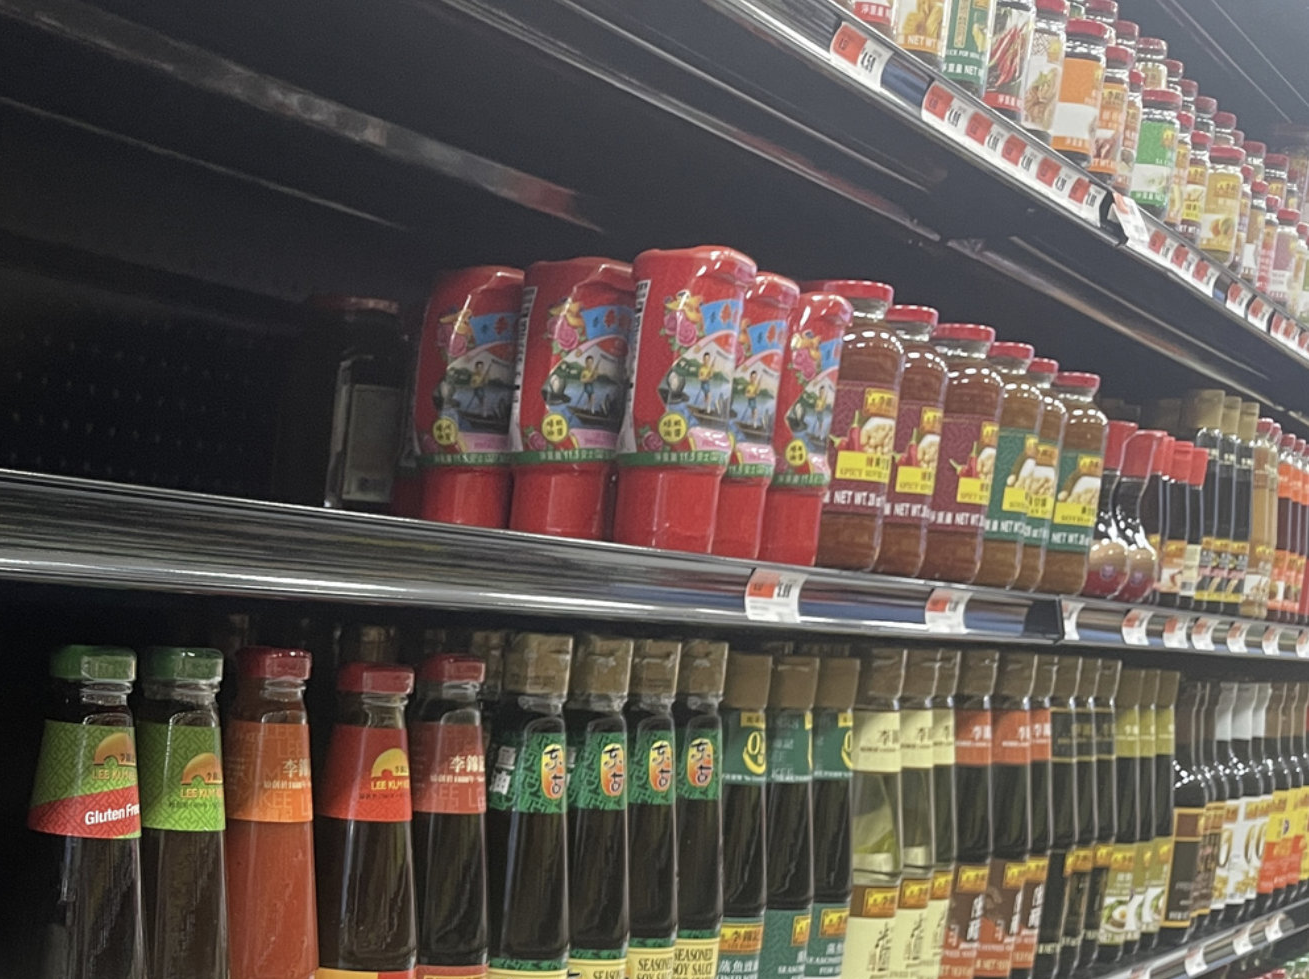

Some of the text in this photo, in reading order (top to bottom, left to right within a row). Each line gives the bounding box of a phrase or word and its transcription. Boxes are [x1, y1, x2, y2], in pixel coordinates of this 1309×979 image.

[908, 35, 924, 46] NET
[834, 491, 858, 504] NET
[894, 503, 910, 517] NET
[954, 513, 970, 526] NET
[181, 788, 197, 798] LEE
[84, 807, 125, 825] Gluten
[674, 948, 714, 963] SEASONED
[673, 961, 714, 976] SOY SAUCE
